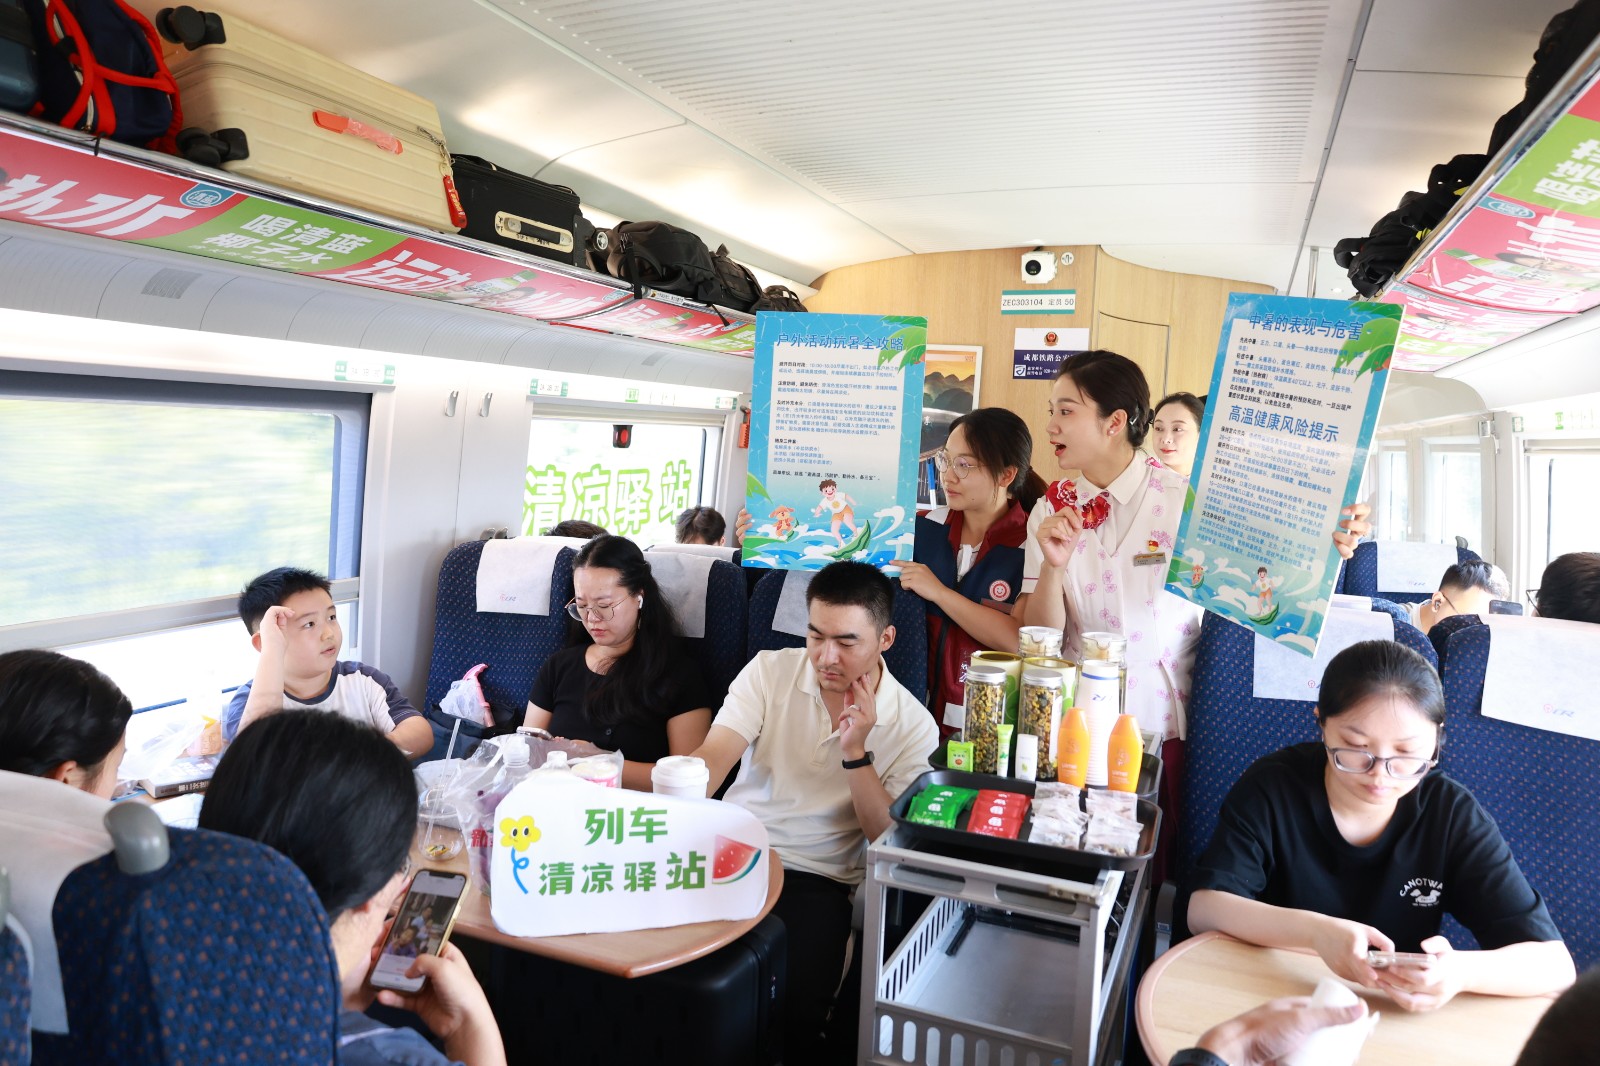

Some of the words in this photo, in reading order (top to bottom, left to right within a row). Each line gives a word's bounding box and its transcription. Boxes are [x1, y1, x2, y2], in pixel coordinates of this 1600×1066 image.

[202, 232, 333, 265] 椰子水
[240, 214, 374, 254] 喝清蓝
[1003, 298, 1043, 307] ZEC303104
[1048, 298, 1062, 306] 定员
[1064, 298, 1075, 306] 50
[777, 333, 904, 352] 户外活动抗暑全攻略
[1249, 313, 1364, 341] 中暑的表现与危害
[1229, 405, 1339, 440] 高温健康风险提示
[522, 459, 692, 537] 清凉驿站
[584, 806, 668, 846] 列车
[538, 850, 707, 896] 清凉驿站
